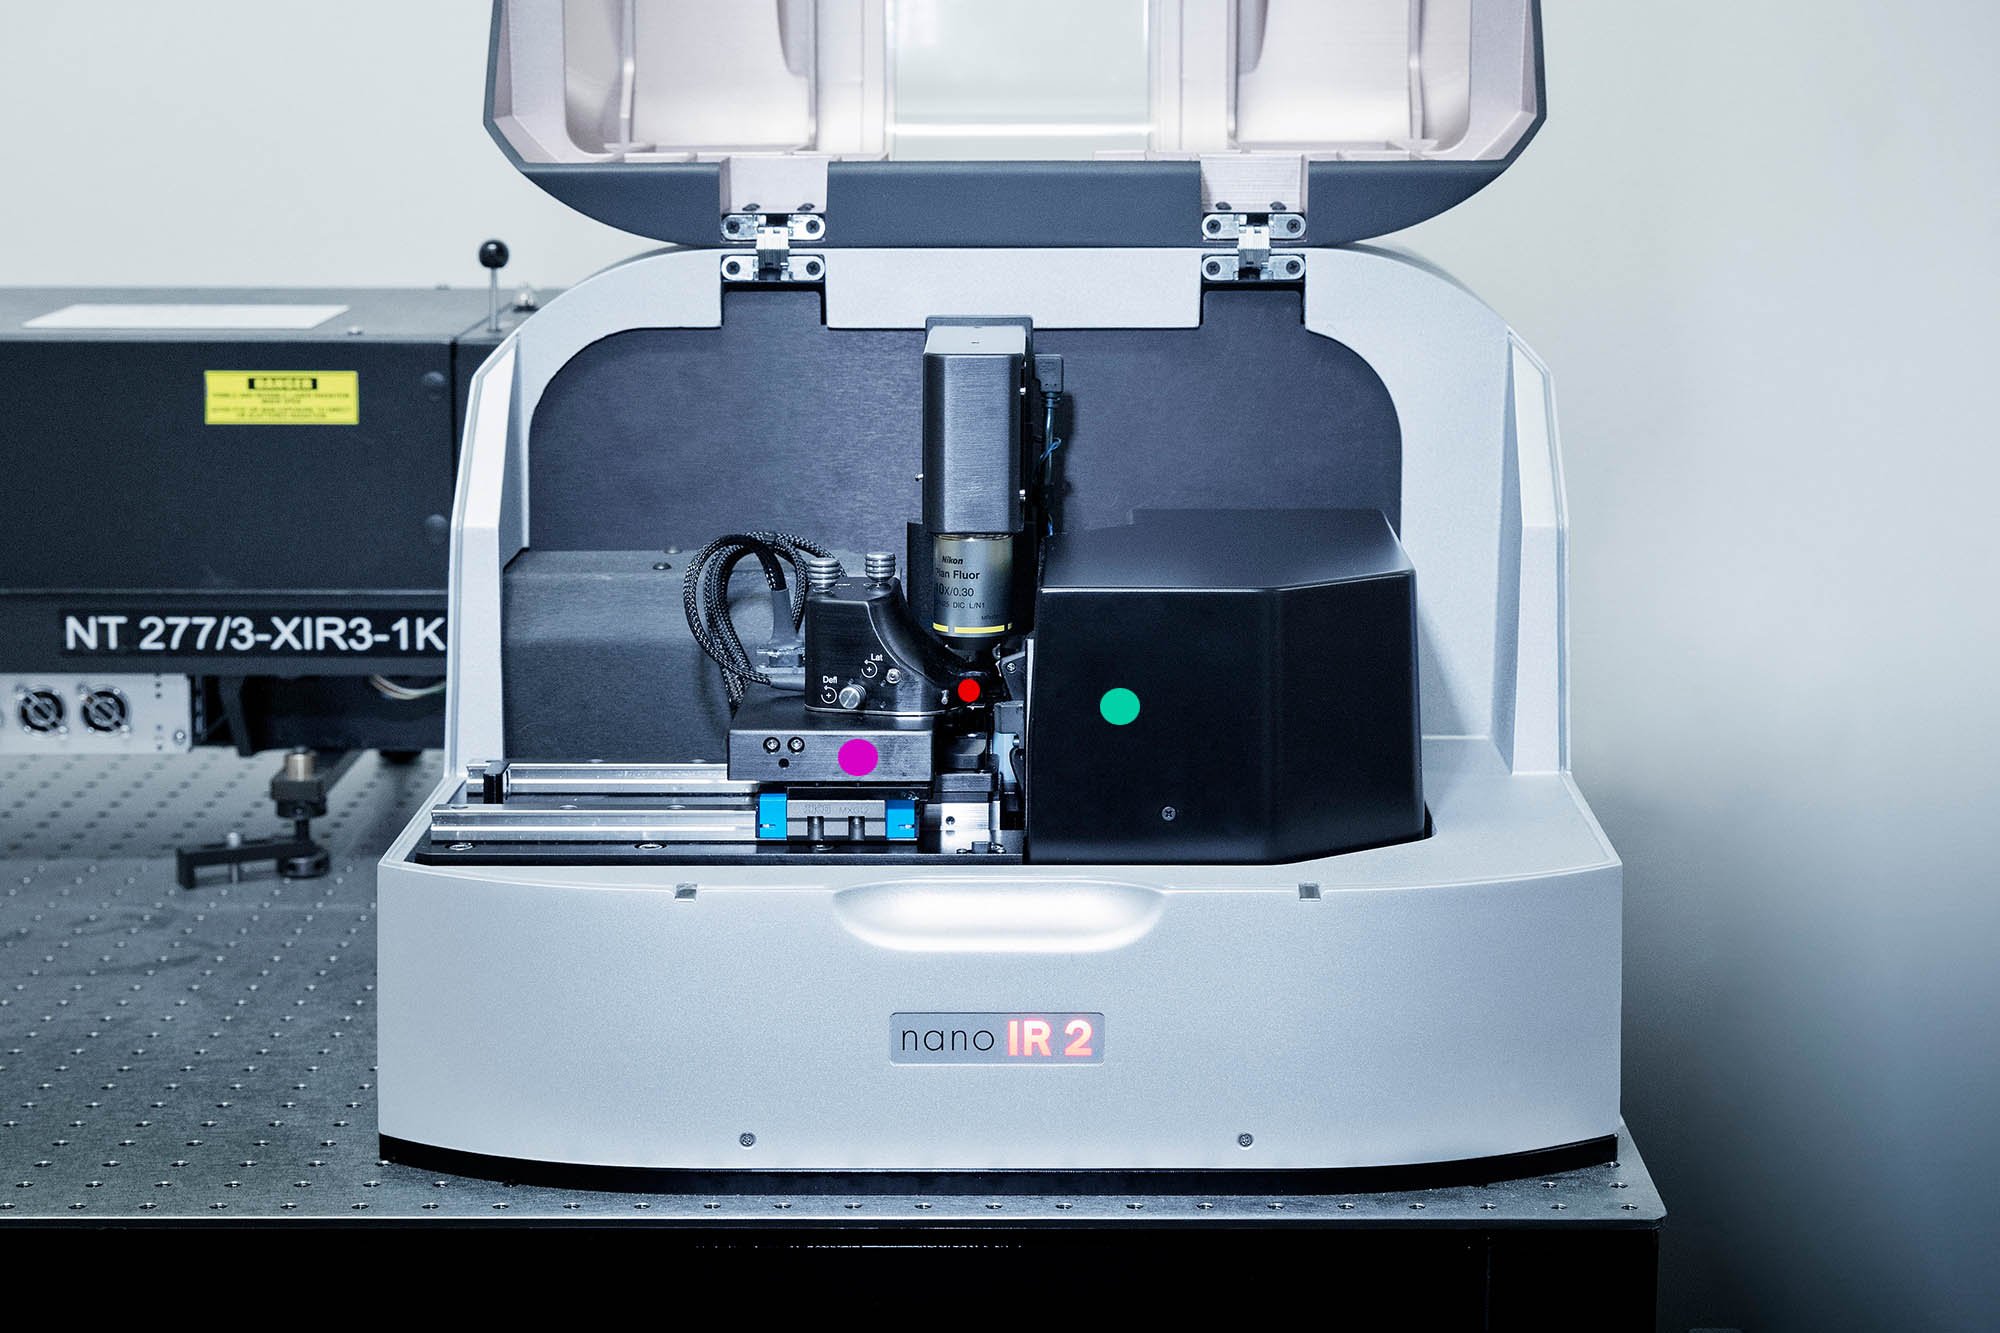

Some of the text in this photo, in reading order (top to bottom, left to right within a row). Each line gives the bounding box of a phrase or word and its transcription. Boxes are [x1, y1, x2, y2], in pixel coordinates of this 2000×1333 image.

[942, 555, 963, 565] Nikon
[953, 570, 980, 580] Fluor
[65, 615, 446, 651] NT 277/3-XIR3-1K
[870, 653, 883, 662] Lat
[902, 1019, 1093, 1056] nano IR 2
